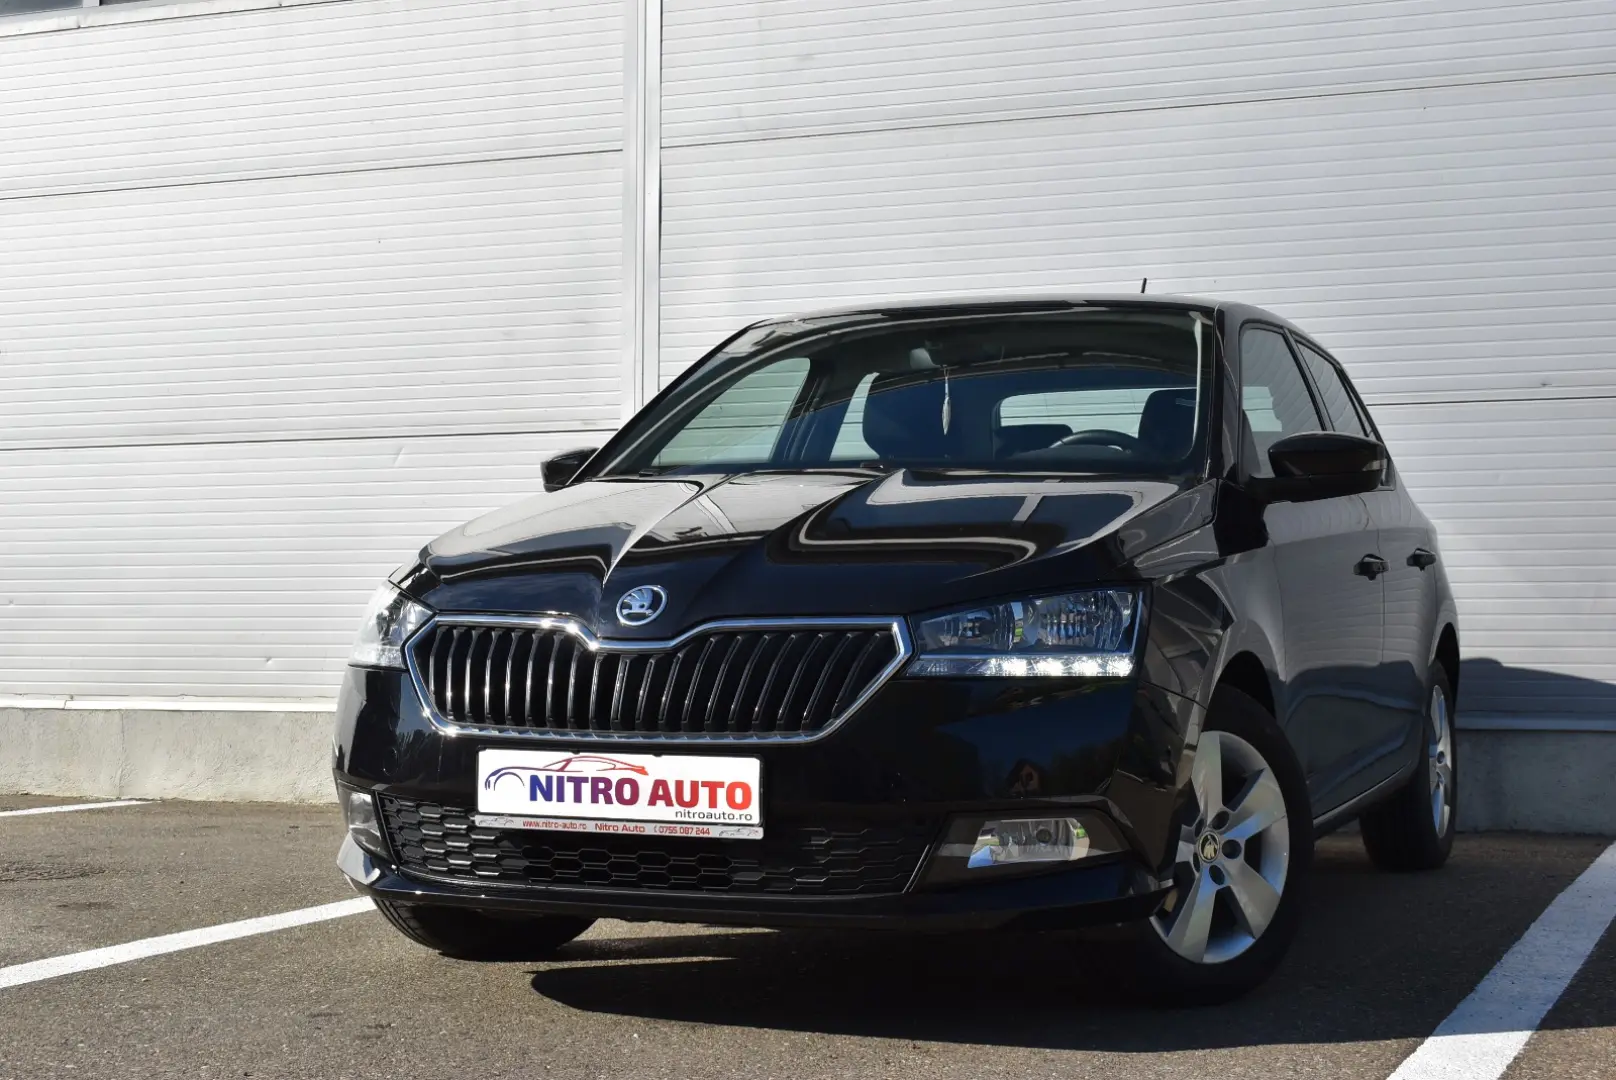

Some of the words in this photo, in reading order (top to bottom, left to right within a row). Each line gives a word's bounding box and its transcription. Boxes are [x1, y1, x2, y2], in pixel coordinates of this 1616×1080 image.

[529, 774, 640, 806] NITRO
[647, 779, 753, 810] AUTO
[675, 808, 753, 821] nitroauto.ro
[522, 820, 588, 830] www.nitro-auto.ro
[594, 822, 619, 832] Nitro
[621, 824, 646, 833] Auto
[659, 825, 678, 835] 0755
[695, 827, 711, 836] 244
